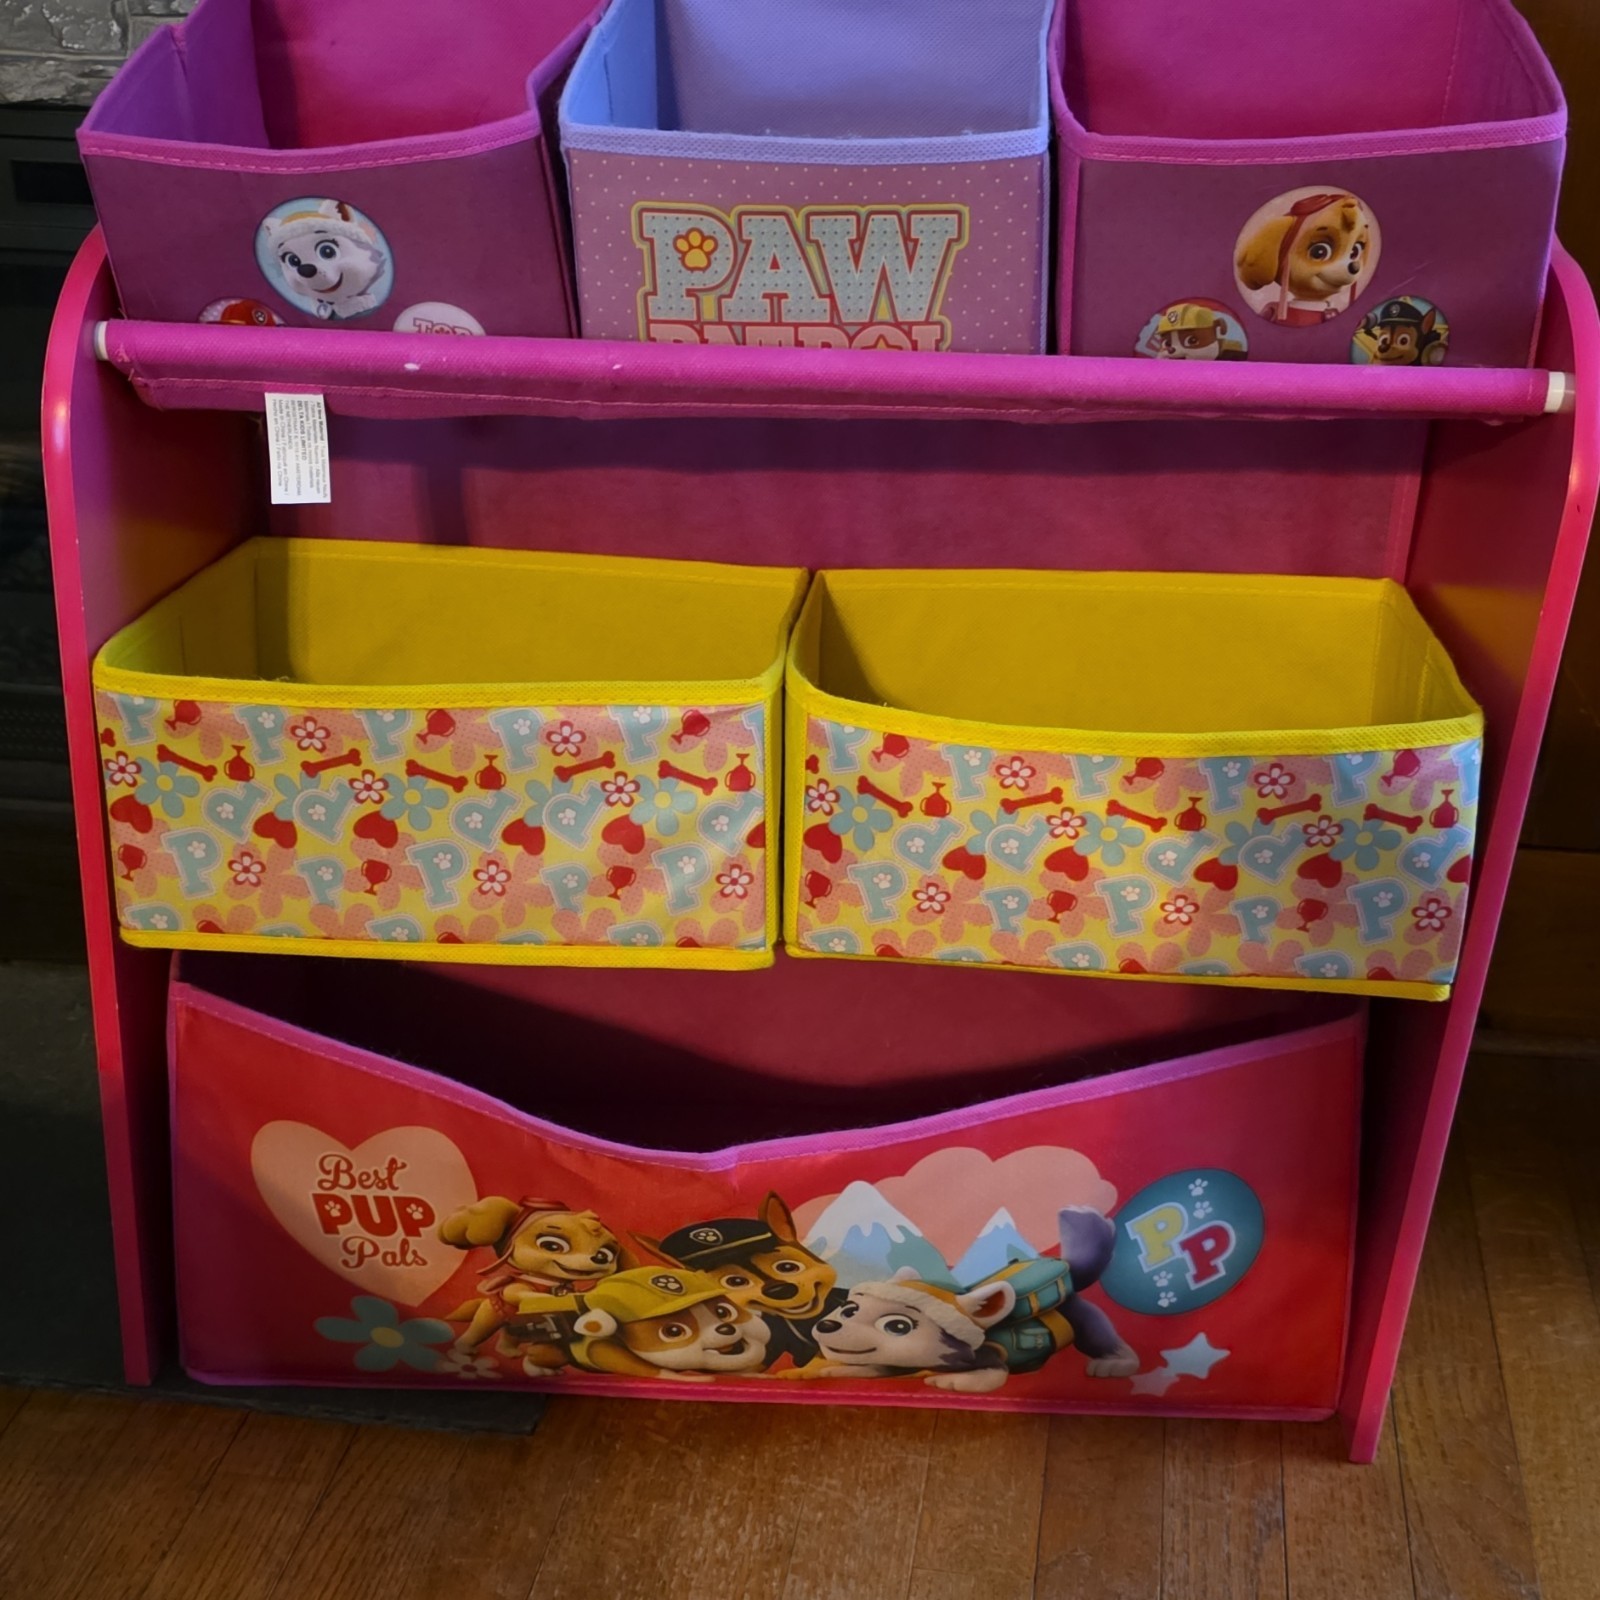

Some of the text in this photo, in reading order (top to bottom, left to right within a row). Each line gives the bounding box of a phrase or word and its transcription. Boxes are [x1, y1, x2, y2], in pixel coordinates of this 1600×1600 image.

[637, 205, 966, 323] PAW
[233, 705, 289, 766] P
[488, 707, 546, 773] P
[940, 744, 998, 801] P
[1197, 756, 1255, 815] P
[203, 780, 274, 844] P
[293, 777, 357, 846] P
[450, 788, 521, 852] P
[542, 781, 606, 850] P
[696, 790, 765, 857] P
[160, 827, 223, 900] P
[892, 816, 966, 874] P
[985, 813, 1050, 874] P
[1143, 829, 1221, 888] P
[1238, 822, 1305, 886] P
[1396, 825, 1472, 890] P
[295, 856, 346, 910] P
[405, 840, 468, 911] P
[540, 862, 593, 916] P
[652, 843, 711, 916] P
[847, 860, 908, 924] P
[1094, 876, 1157, 937] P
[980, 886, 1033, 936] P
[1230, 896, 1283, 945] P
[1347, 877, 1410, 946] P
[317, 1154, 408, 1191] Best
[311, 1192, 435, 1237] PUP
[341, 1236, 428, 1269] Pals
